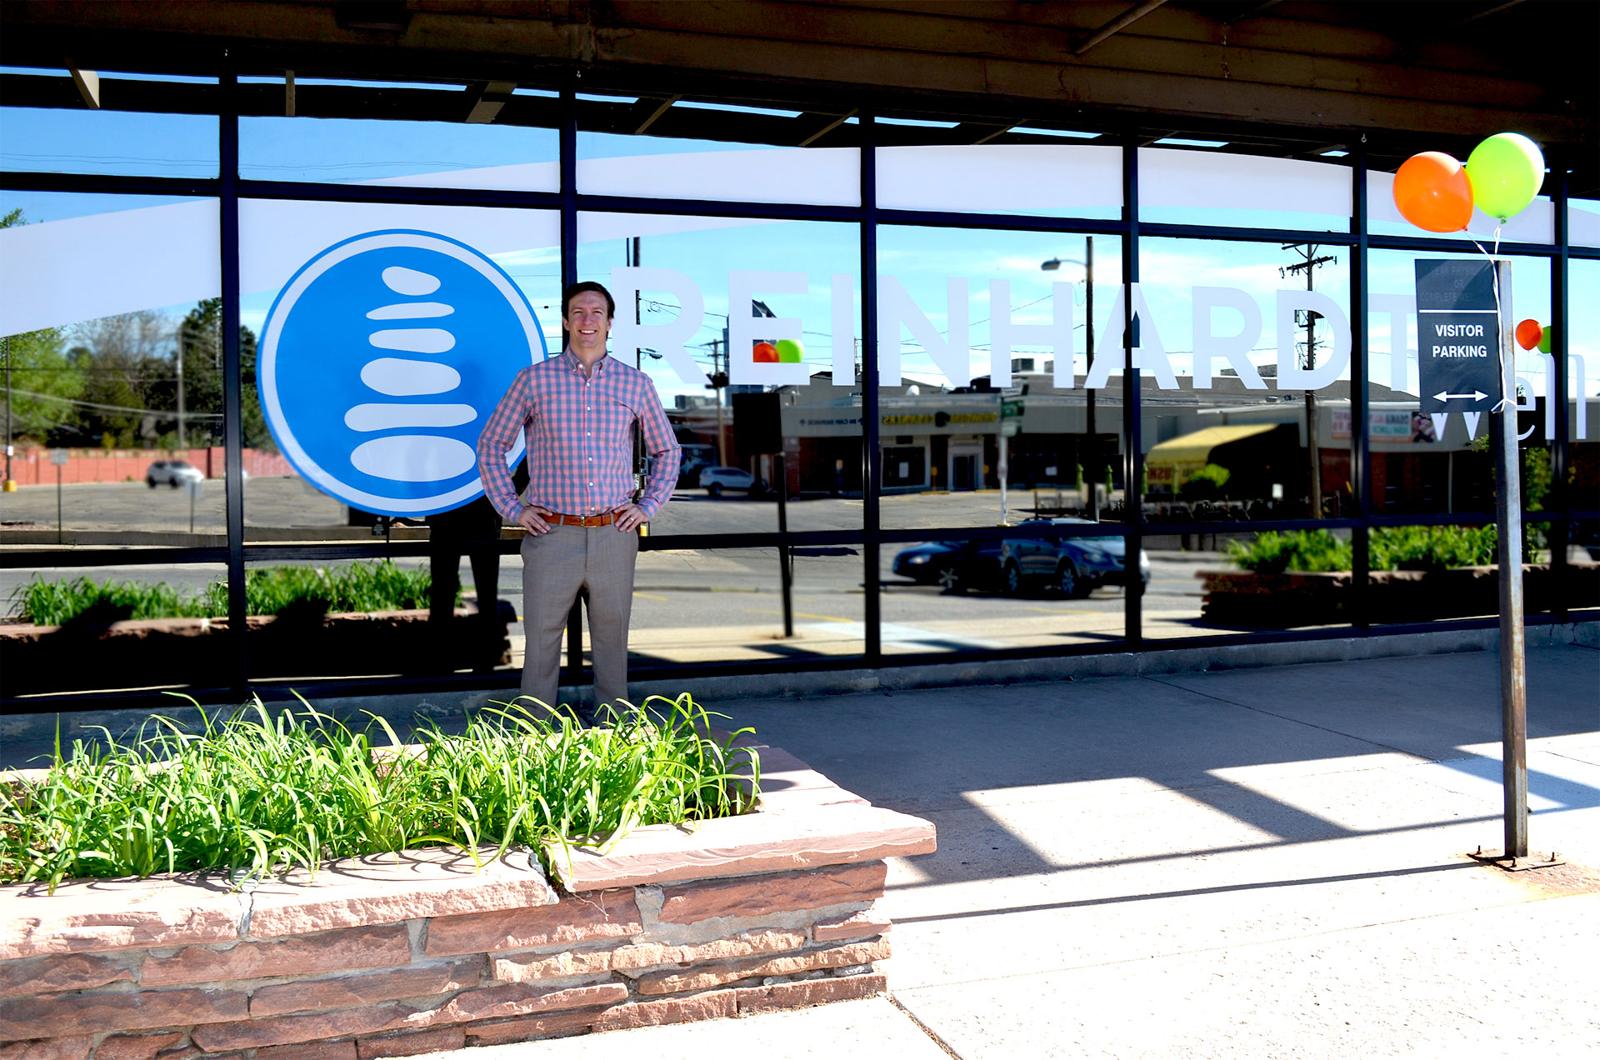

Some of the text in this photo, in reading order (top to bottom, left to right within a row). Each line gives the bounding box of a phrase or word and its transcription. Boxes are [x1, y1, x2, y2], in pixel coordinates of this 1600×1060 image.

[610, 266, 1418, 391] REINHARDT
[1435, 324, 1484, 337] VISITOR
[1432, 345, 1487, 358] PARKING
